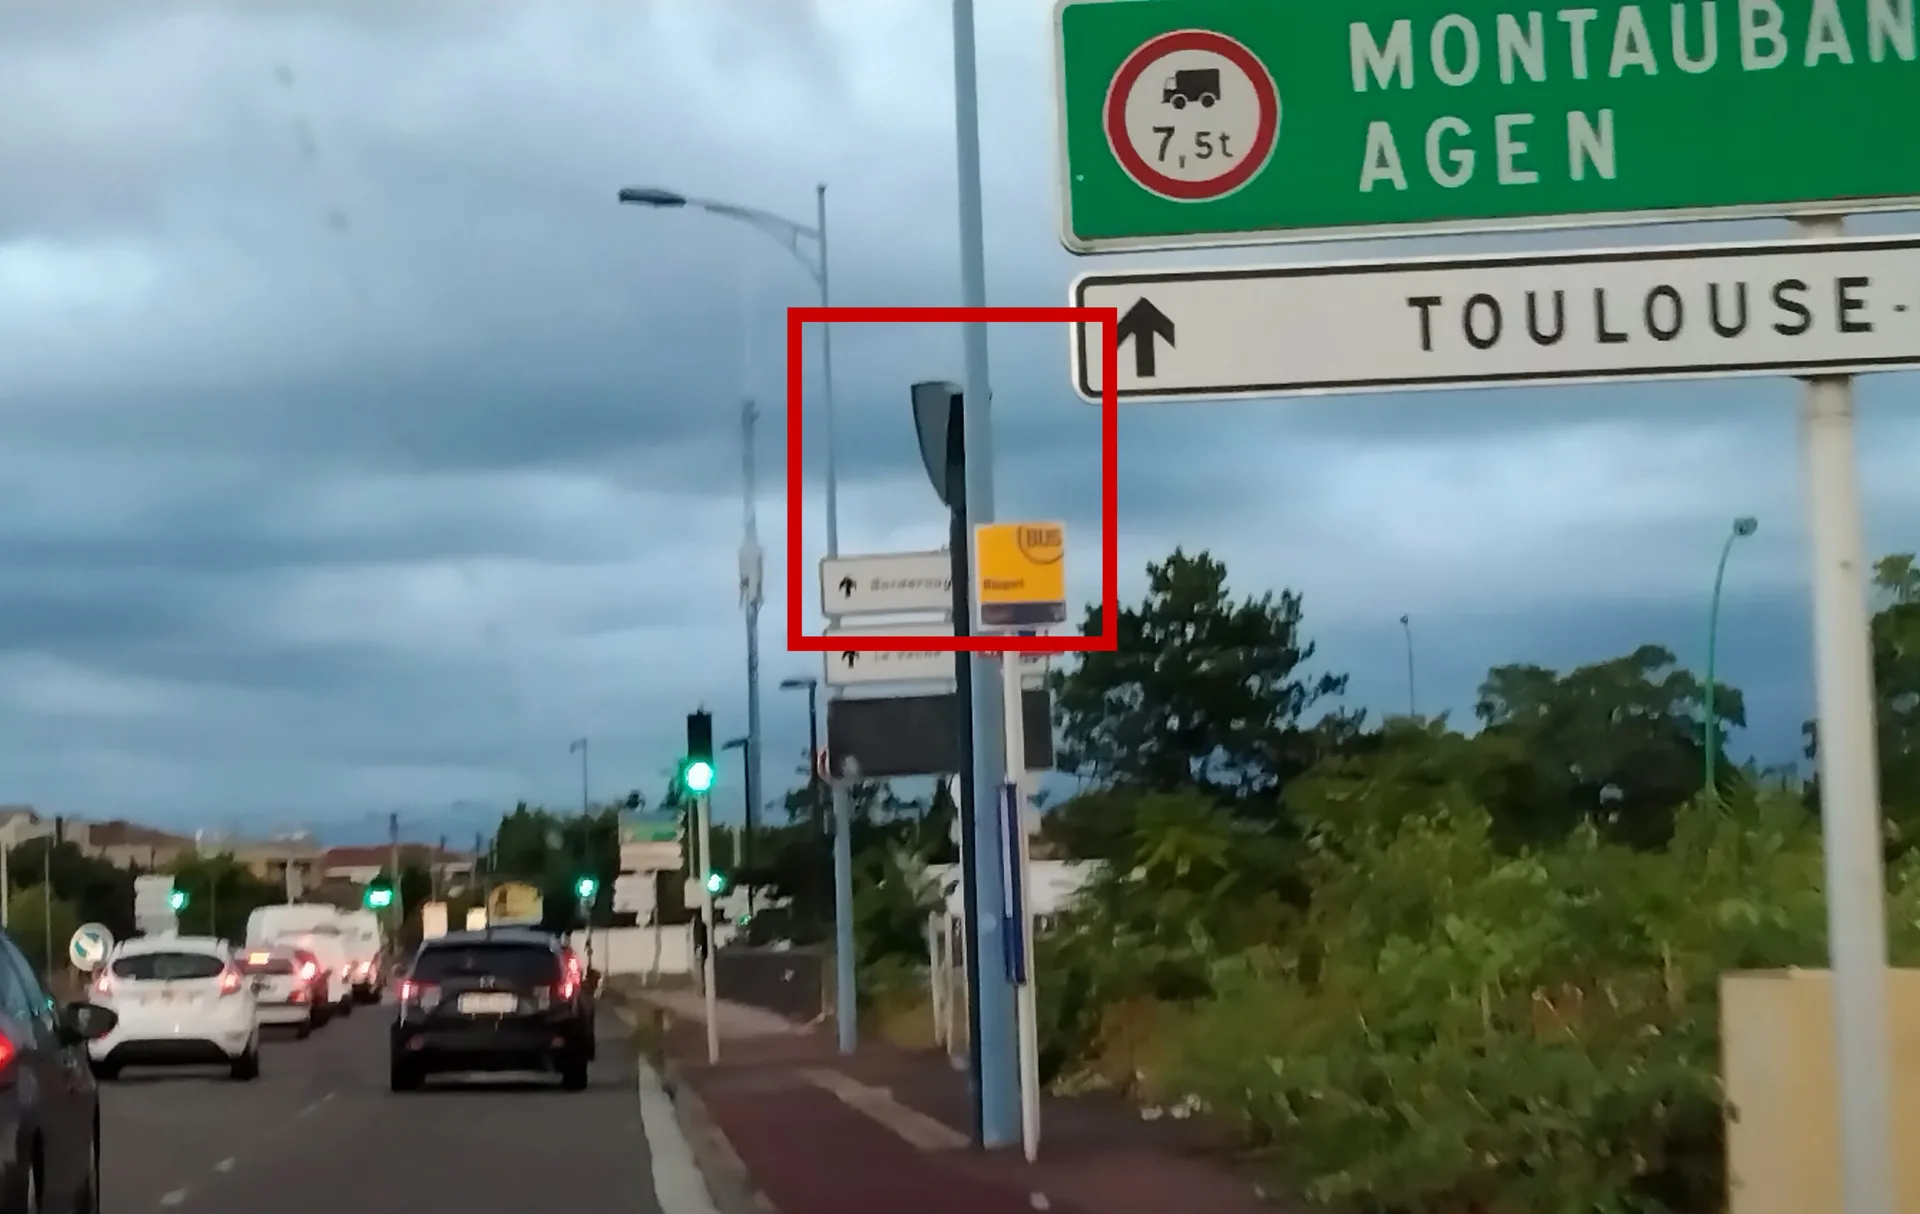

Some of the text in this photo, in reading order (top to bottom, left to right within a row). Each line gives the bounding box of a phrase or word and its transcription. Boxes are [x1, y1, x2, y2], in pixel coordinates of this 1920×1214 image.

[1349, 0, 1917, 92] MONTAUBAN
[1152, 126, 1234, 168] 7,5t
[1359, 109, 1617, 192] AGEN
[1026, 528, 1063, 549] BUS
